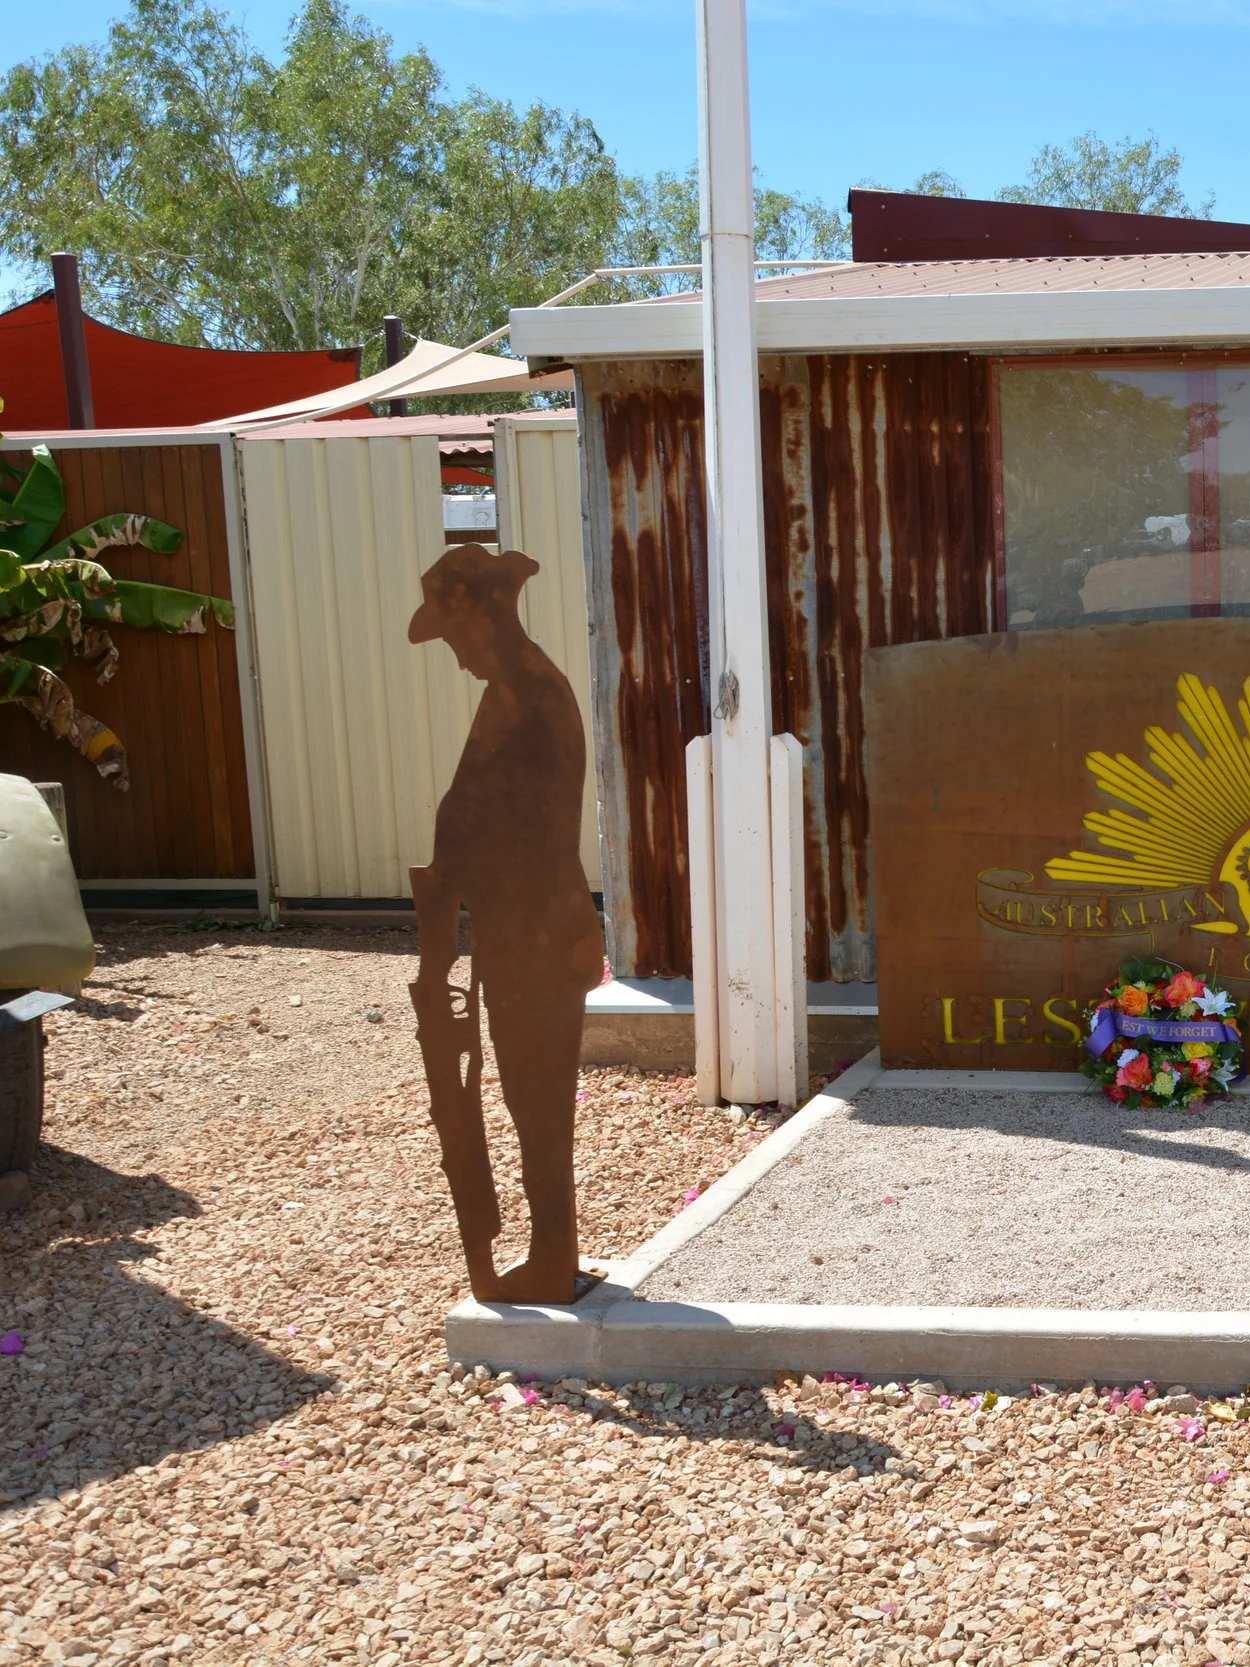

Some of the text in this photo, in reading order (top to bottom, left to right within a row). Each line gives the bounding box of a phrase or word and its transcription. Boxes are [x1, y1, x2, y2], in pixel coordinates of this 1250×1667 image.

[992, 891, 1226, 929] AUSTRALIAN
[942, 997, 1103, 1046] LES
[1146, 1025, 1167, 1037] WE
[1169, 1026, 1217, 1037] FORGET
